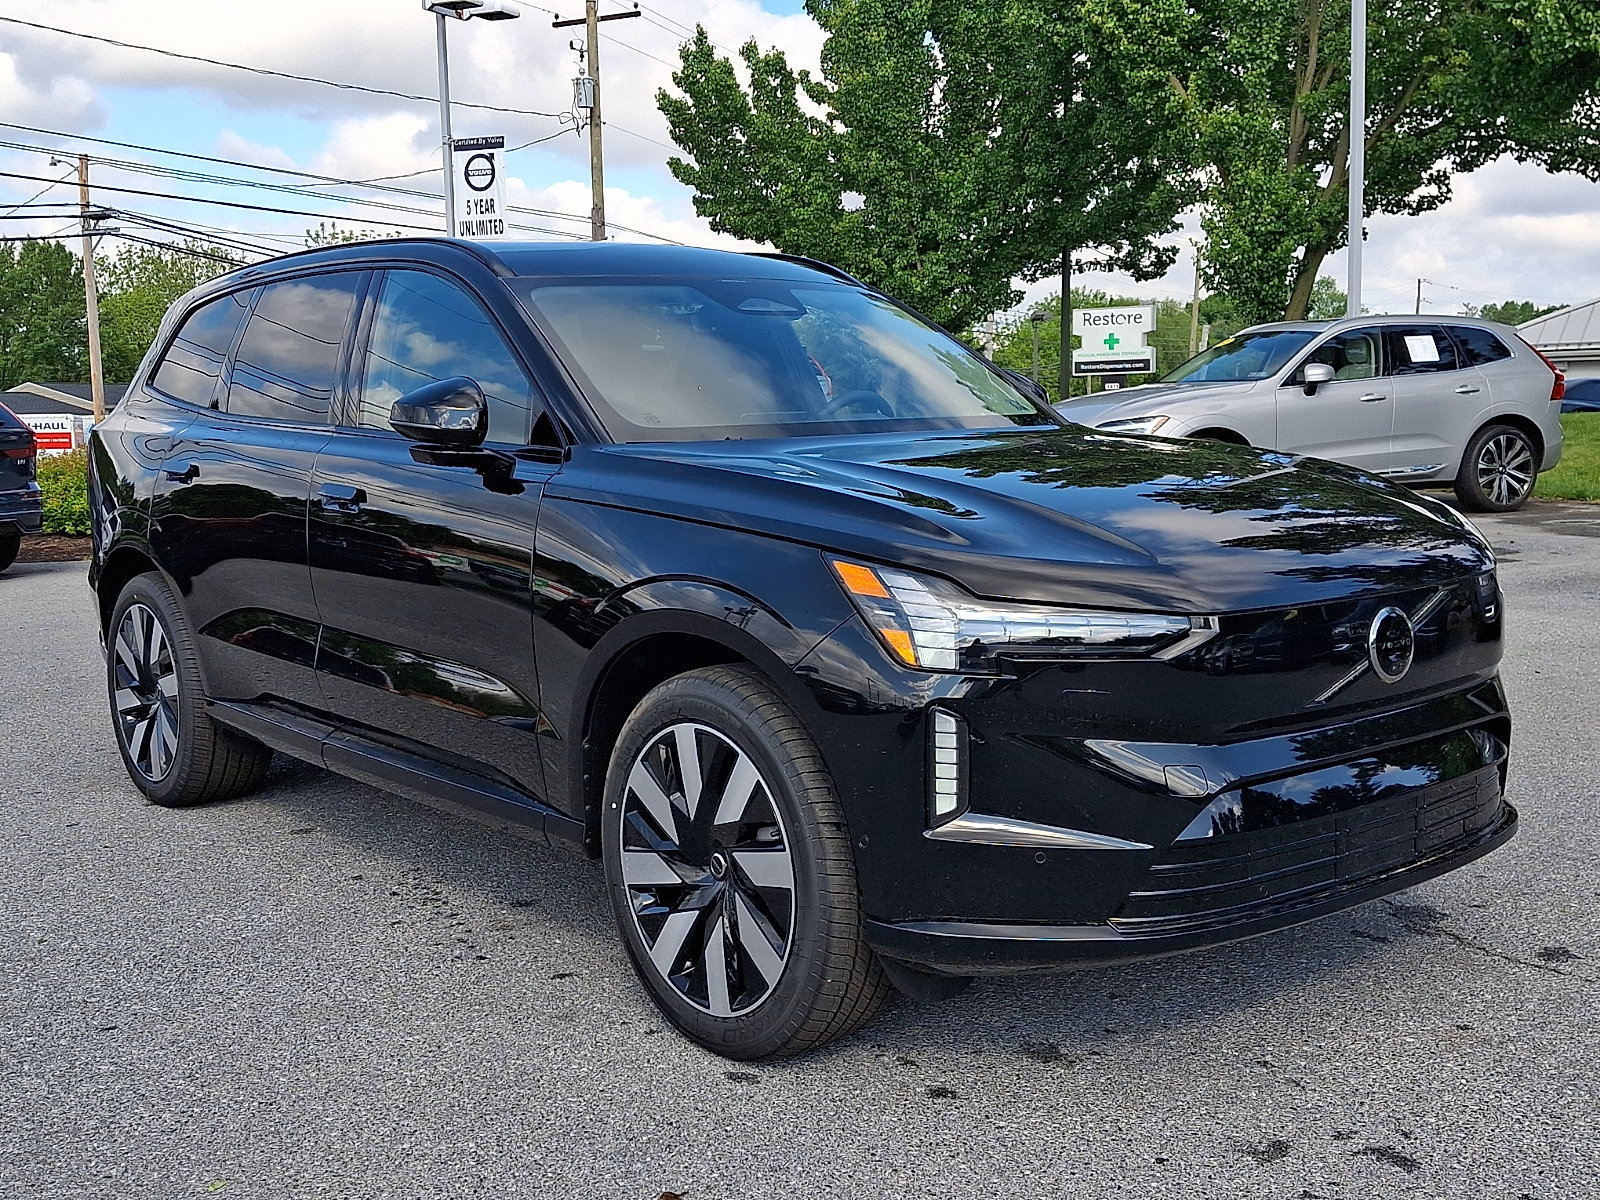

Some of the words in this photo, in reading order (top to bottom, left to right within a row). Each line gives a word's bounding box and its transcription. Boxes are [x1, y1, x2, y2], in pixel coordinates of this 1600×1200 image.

[454, 138, 478, 146] Certified
[478, 138, 487, 146] By
[466, 199, 472, 216] 5
[473, 198, 496, 215] YEAR
[459, 218, 504, 236] UNLIMITED
[1082, 312, 1143, 327] Restore
[1080, 362, 1144, 370] RestoreDispensaries.com
